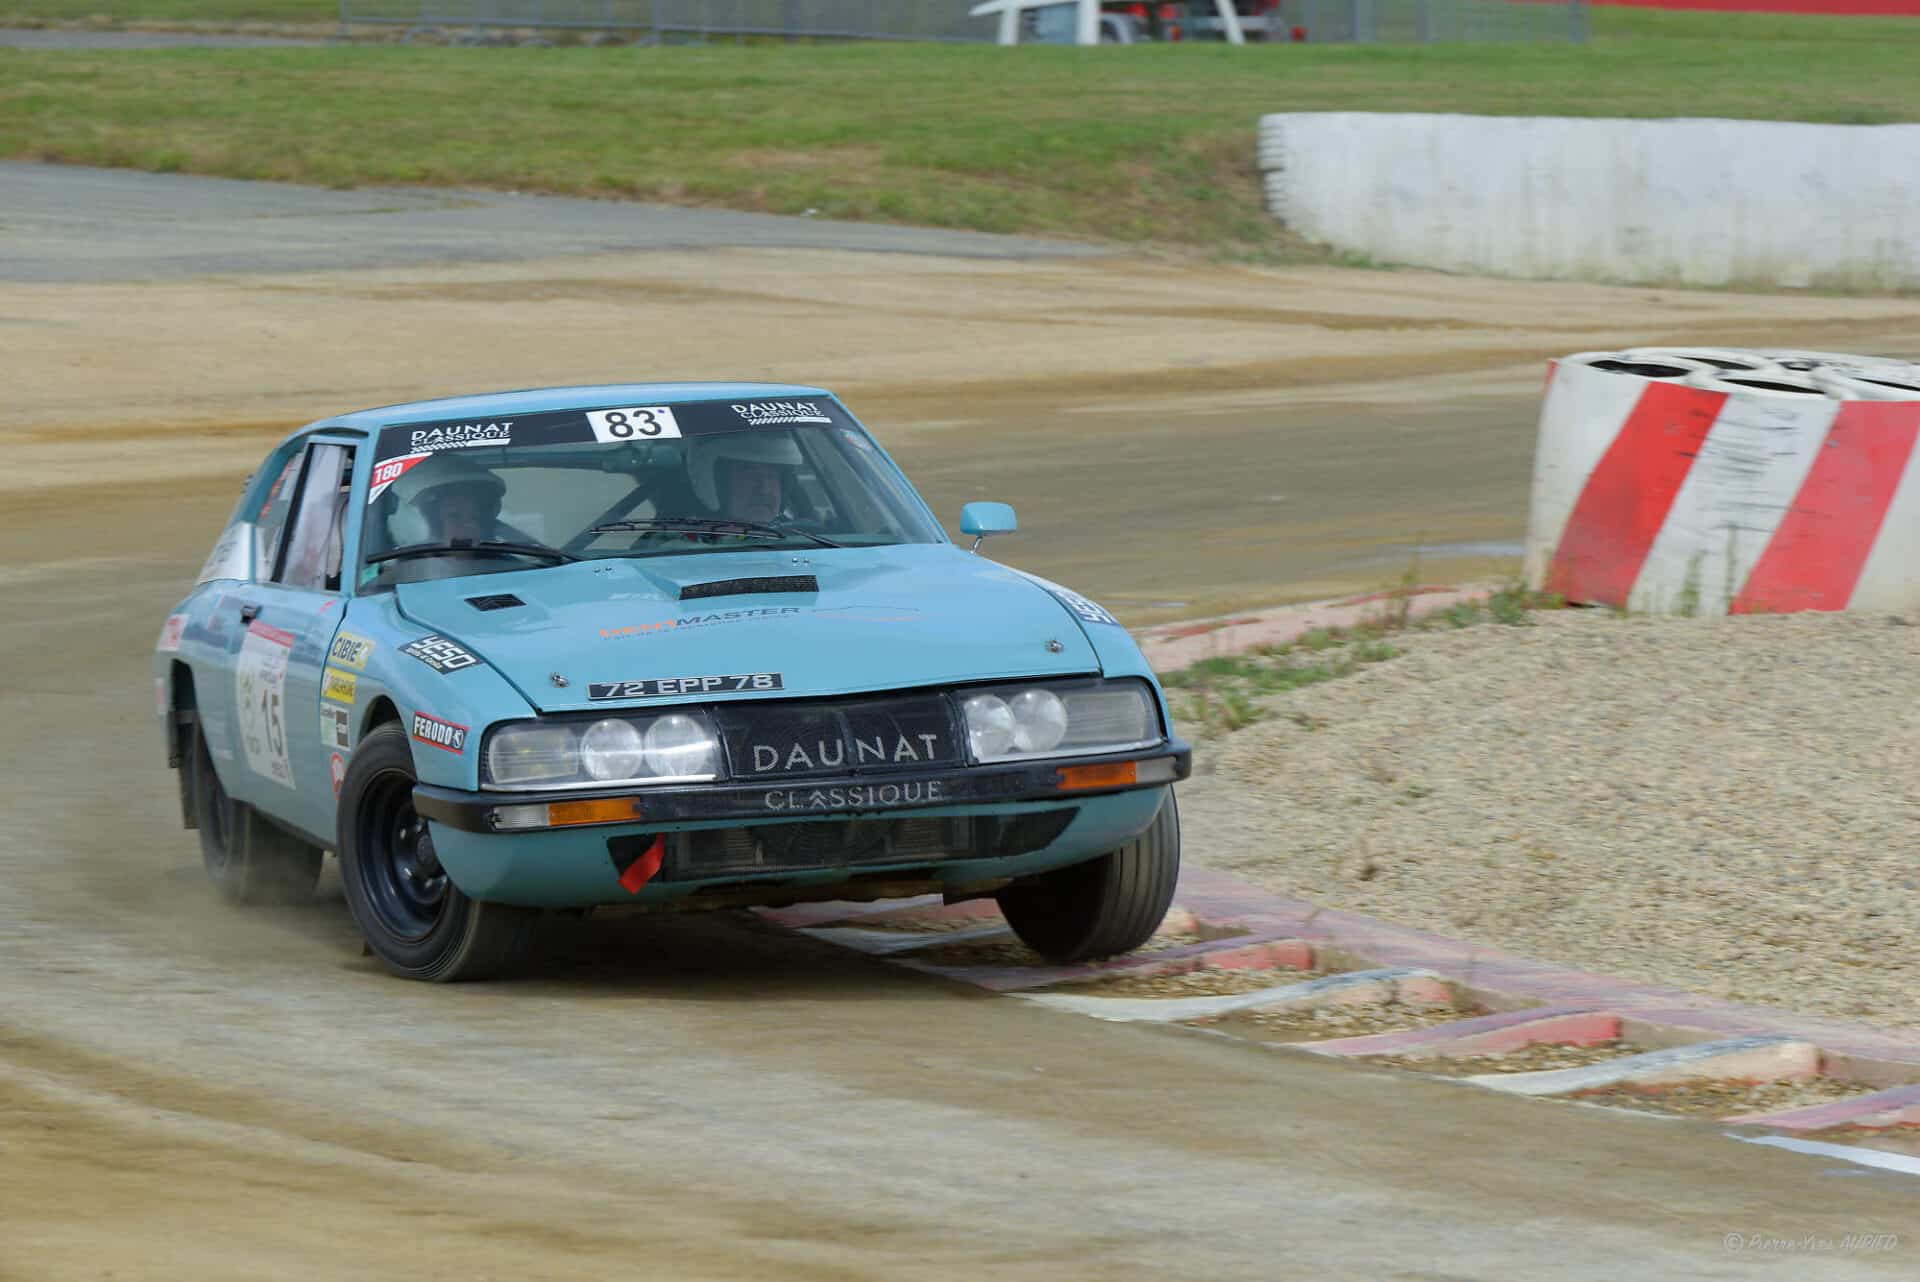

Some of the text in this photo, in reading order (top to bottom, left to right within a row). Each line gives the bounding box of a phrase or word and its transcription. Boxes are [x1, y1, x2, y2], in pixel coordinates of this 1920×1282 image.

[731, 402, 818, 414] DAUNAT
[411, 422, 513, 440] DAUNAT
[605, 410, 662, 438] 83
[411, 431, 512, 447] CLASSIQUE
[375, 462, 404, 484] 180
[602, 674, 773, 697] 72 EPP 78
[413, 715, 453, 746] FERODO
[753, 734, 937, 772] DAUNAT
[764, 781, 943, 809] CLASSIQUE
